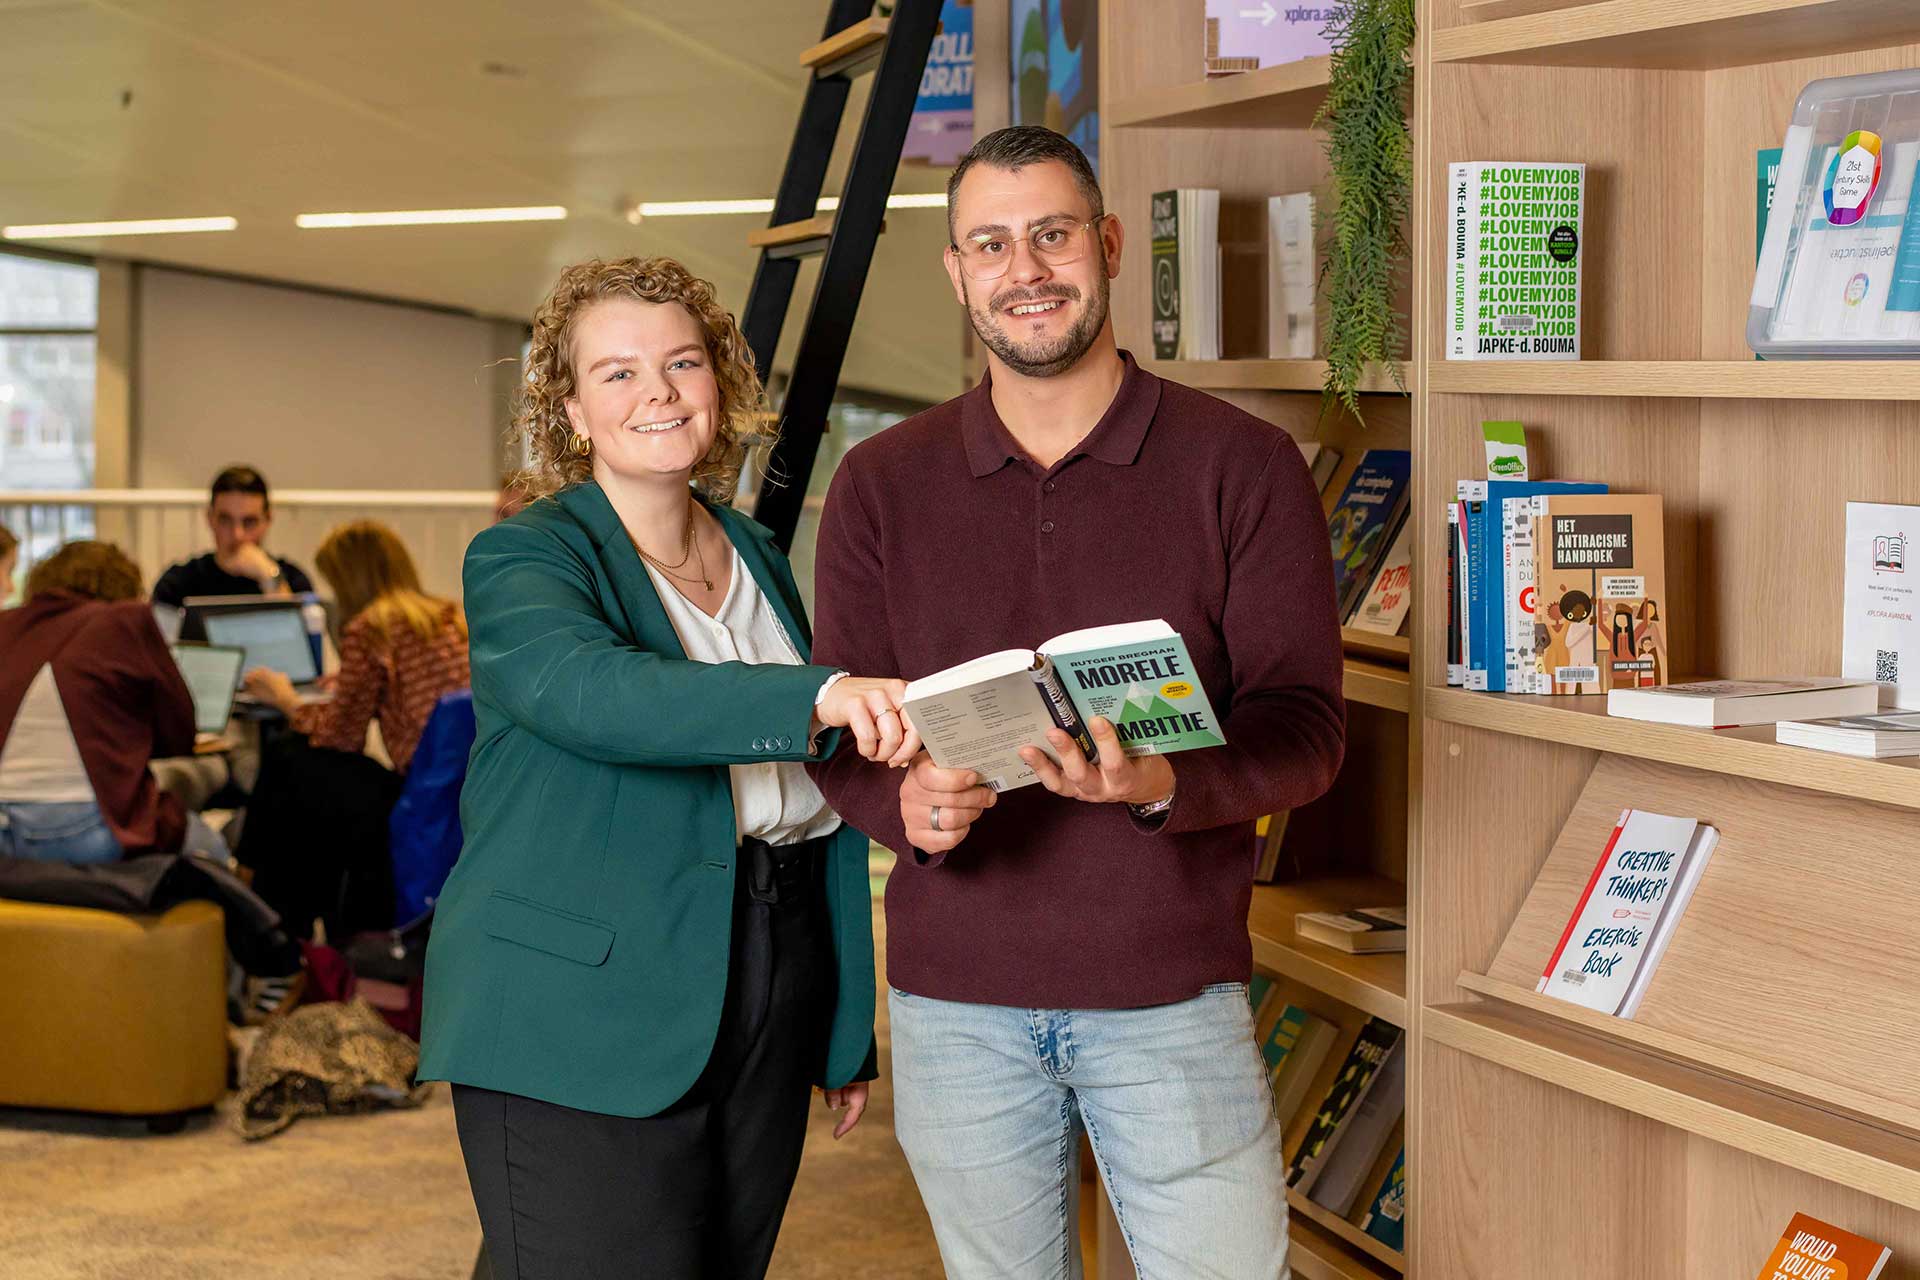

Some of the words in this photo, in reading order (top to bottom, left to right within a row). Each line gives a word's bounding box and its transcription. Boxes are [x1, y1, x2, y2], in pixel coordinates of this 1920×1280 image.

[1846, 161, 1861, 172] 21st
[1480, 168, 1580, 184] #LOVEMYJOB
[1480, 185, 1580, 201] #LOVEMYJOB
[1839, 187, 1858, 196] Game
[1480, 202, 1579, 218] #LOVEMYJOB
[1456, 219, 1466, 260] BOUMA
[1479, 270, 1577, 286] #LOVEMYJOB
[1455, 263, 1465, 332] #LOVEMYJOB
[1479, 287, 1577, 303] #LOVEMYJOB
[1477, 337, 1532, 353] JAPKE-d.
[1533, 338, 1576, 353] BOUMA
[1491, 462, 1524, 472] GreenOffice
[1556, 519, 1576, 533] HET
[1557, 533, 1628, 548] ANTIRACISME
[1557, 549, 1614, 563] HANDBOEK
[1070, 656, 1115, 667] RUTGER
[1118, 647, 1176, 661] BREGMAN
[1074, 655, 1184, 690] MORELE
[1617, 850, 1676, 872] CREATIVE
[1582, 950, 1623, 978] BOOK
[1789, 1230, 1838, 1262] WOULD
[1778, 1250, 1810, 1276] YOU
[1802, 1259, 1836, 1280] LIKE
